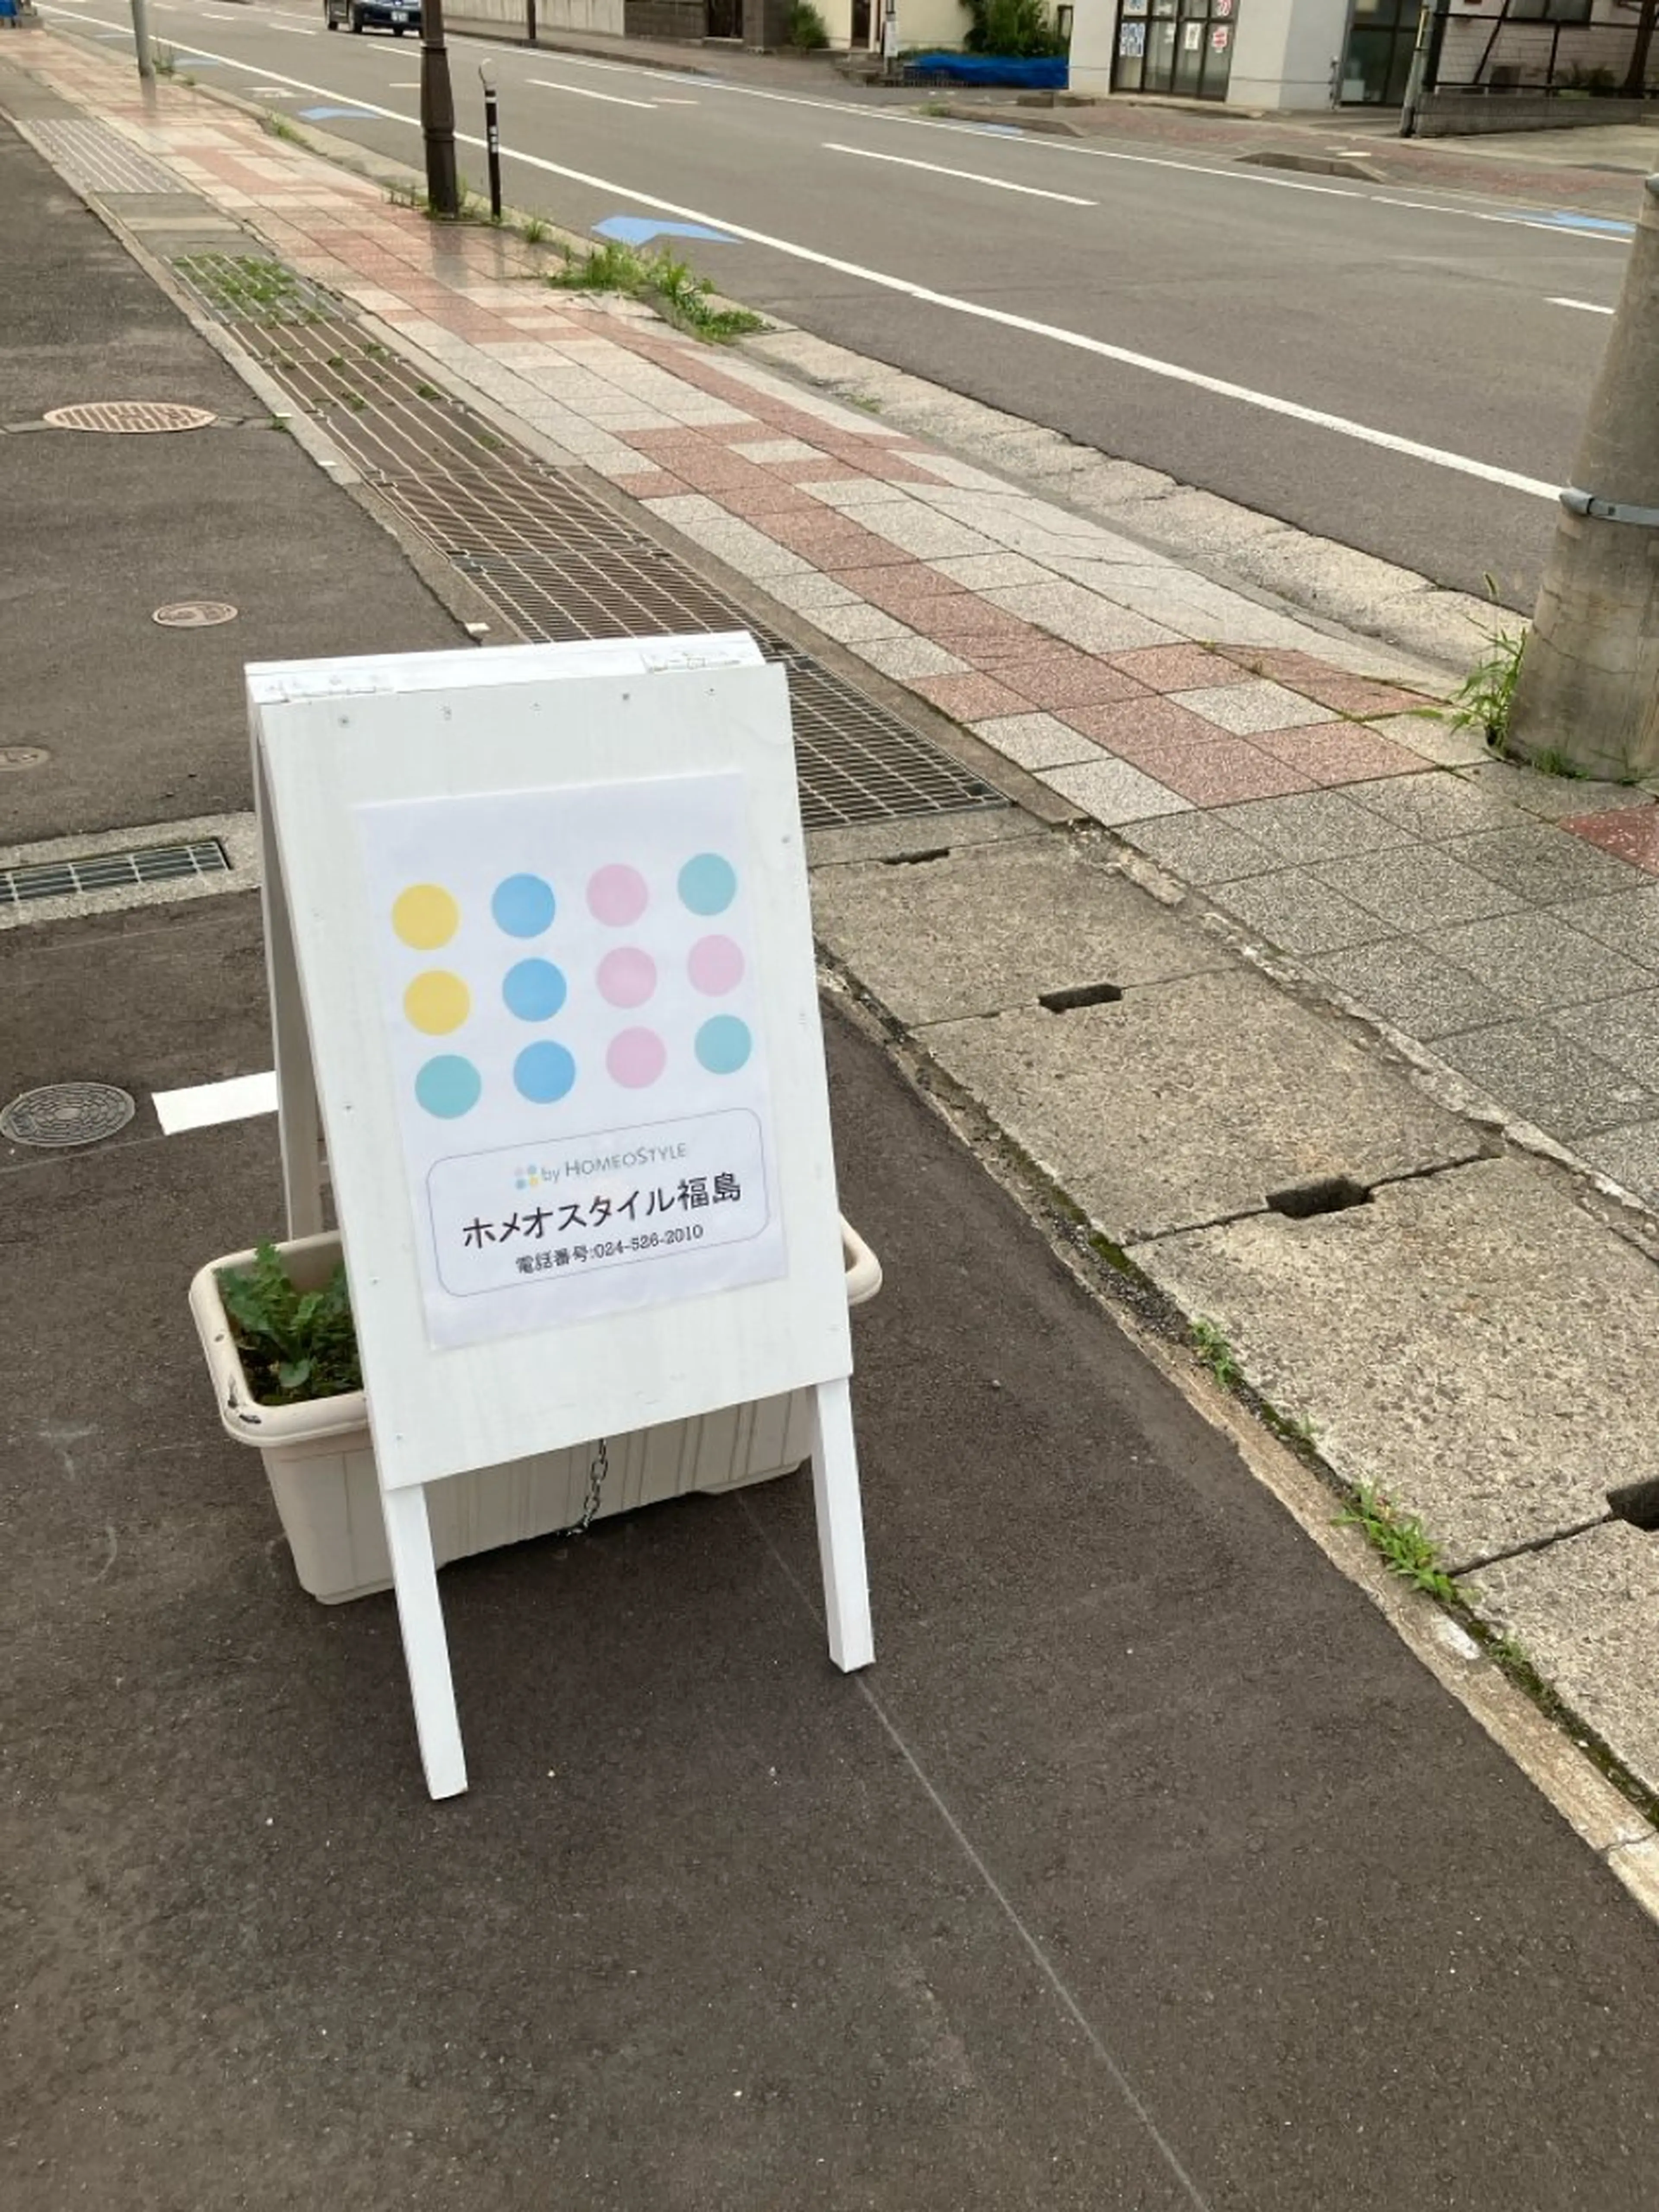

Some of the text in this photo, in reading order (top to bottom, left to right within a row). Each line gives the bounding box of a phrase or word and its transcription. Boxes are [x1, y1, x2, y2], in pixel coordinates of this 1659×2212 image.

[541, 1167, 559, 1183] by
[463, 1172, 741, 1249] ホメオスタイル福島
